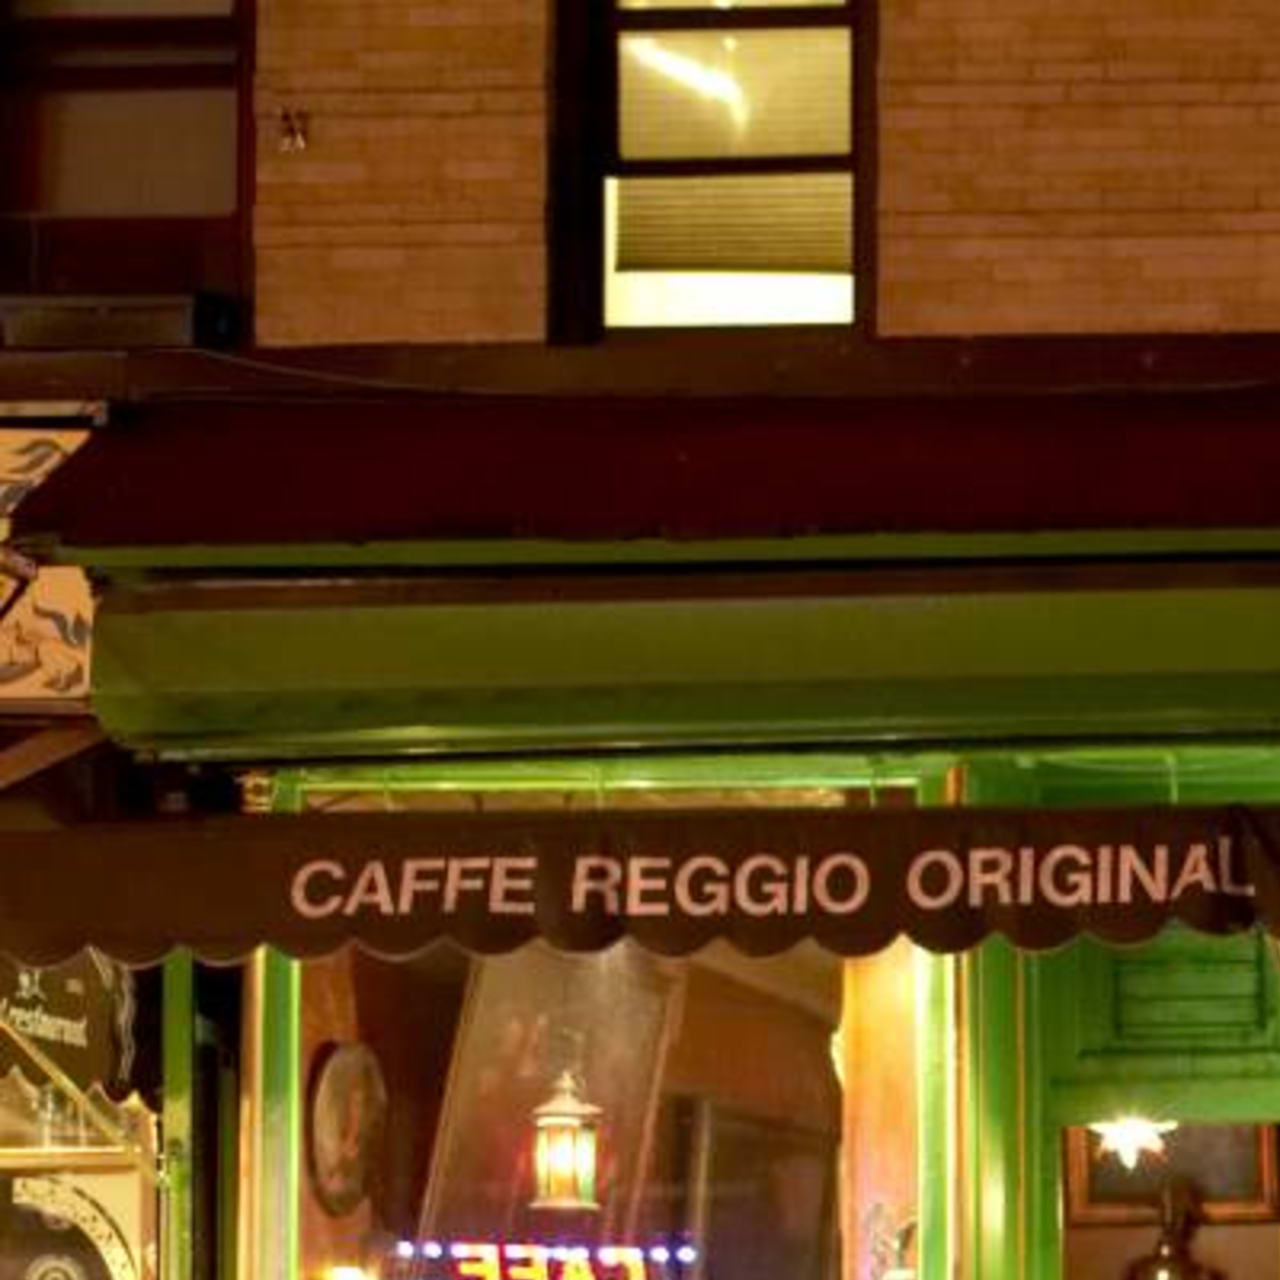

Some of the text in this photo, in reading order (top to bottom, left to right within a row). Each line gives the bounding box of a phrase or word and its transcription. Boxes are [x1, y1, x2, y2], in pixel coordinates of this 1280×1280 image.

[290, 856, 538, 920] CAFFE
[571, 852, 872, 917] REGGIO
[907, 836, 1256, 910] ORIGINAL
